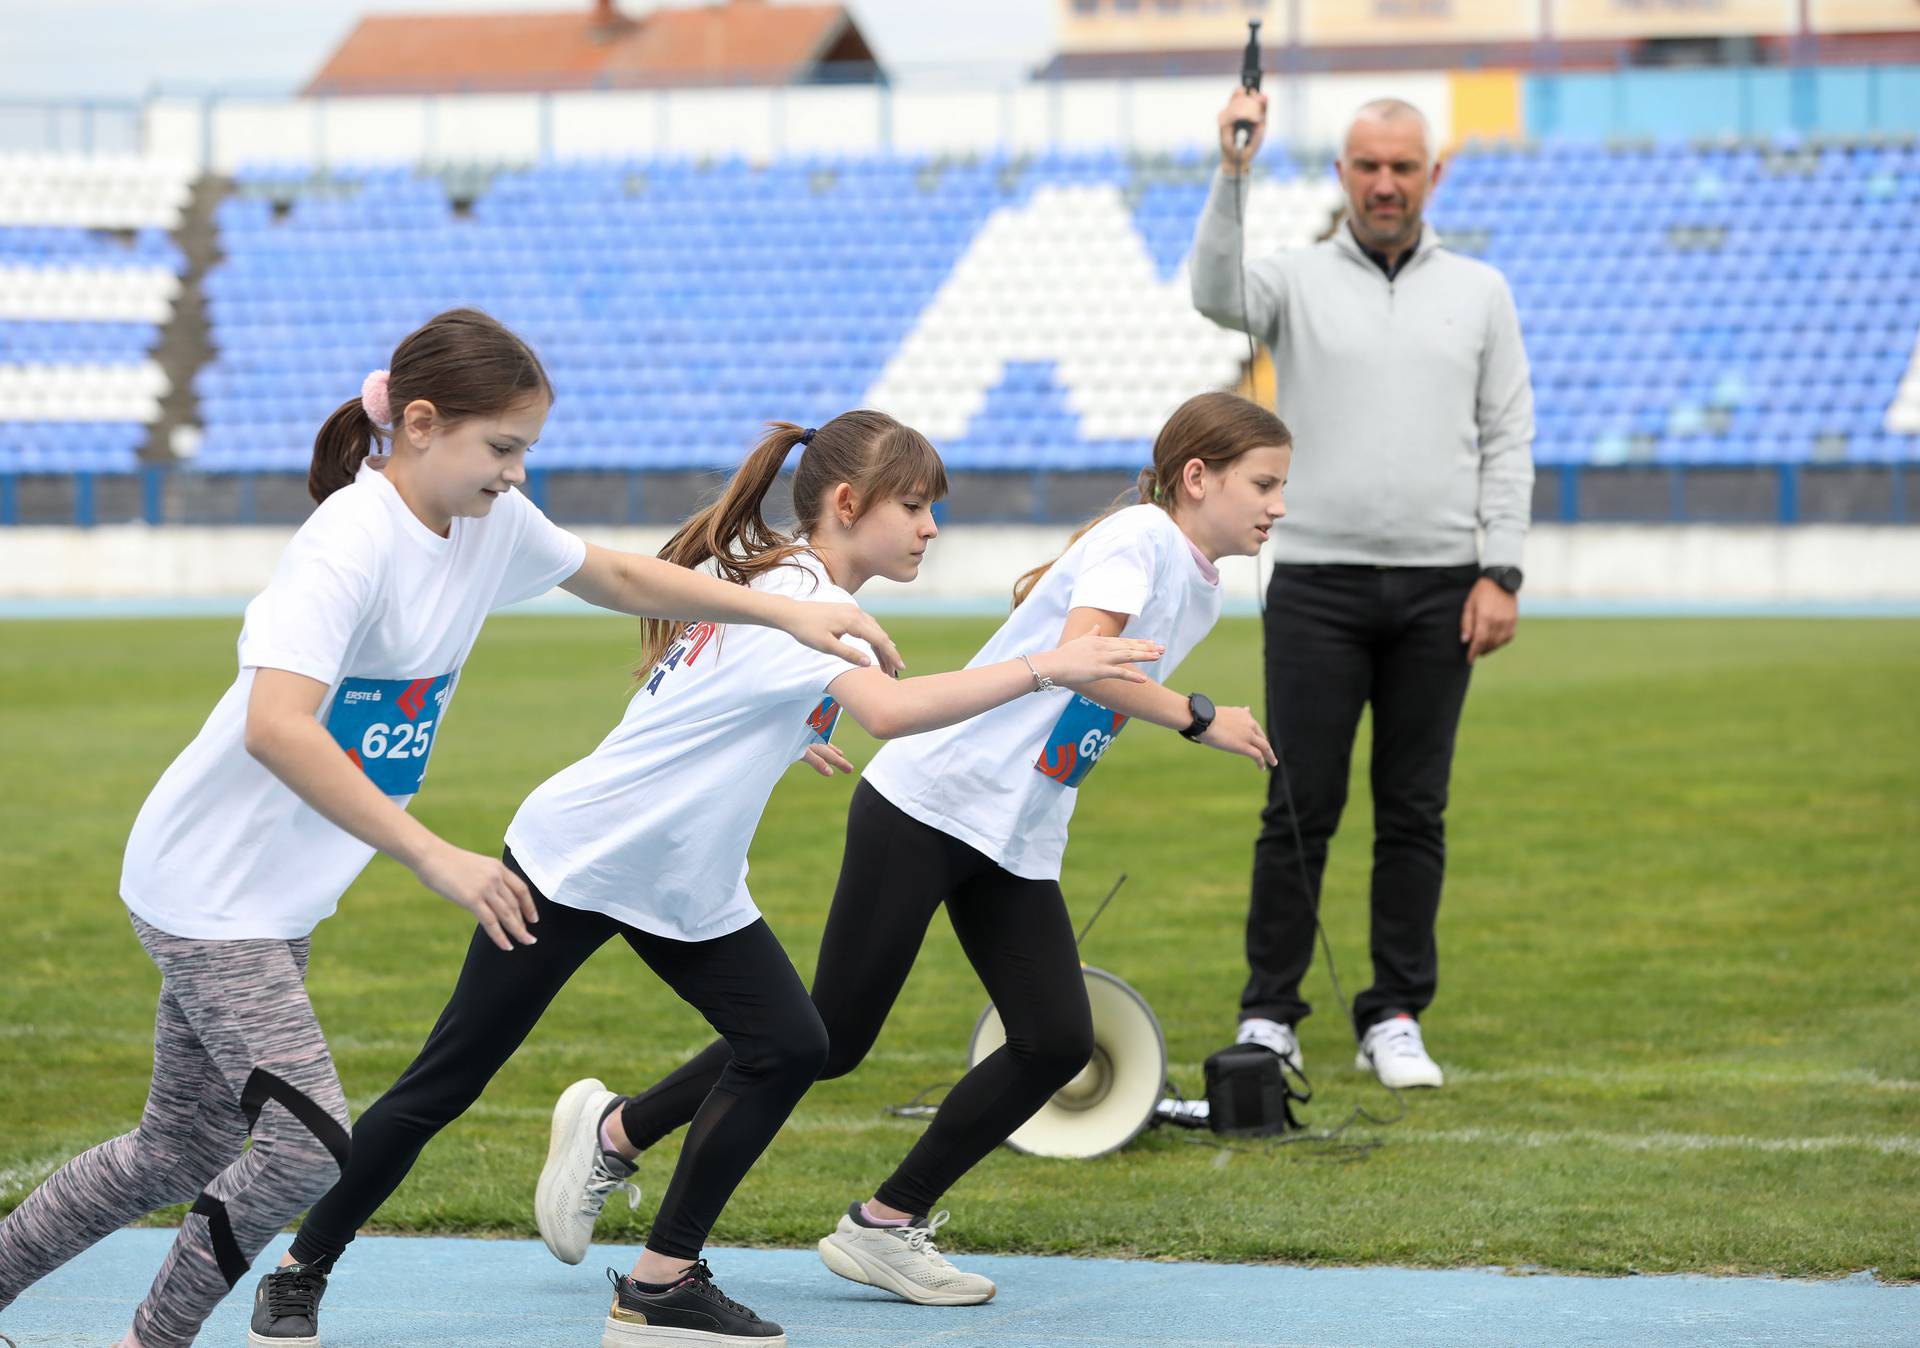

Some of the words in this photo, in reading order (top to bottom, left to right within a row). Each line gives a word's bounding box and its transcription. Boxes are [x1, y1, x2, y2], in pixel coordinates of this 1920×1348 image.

[346, 691, 372, 700] ERSTE
[361, 720, 433, 759] 625
[1079, 728, 1116, 762] 63
